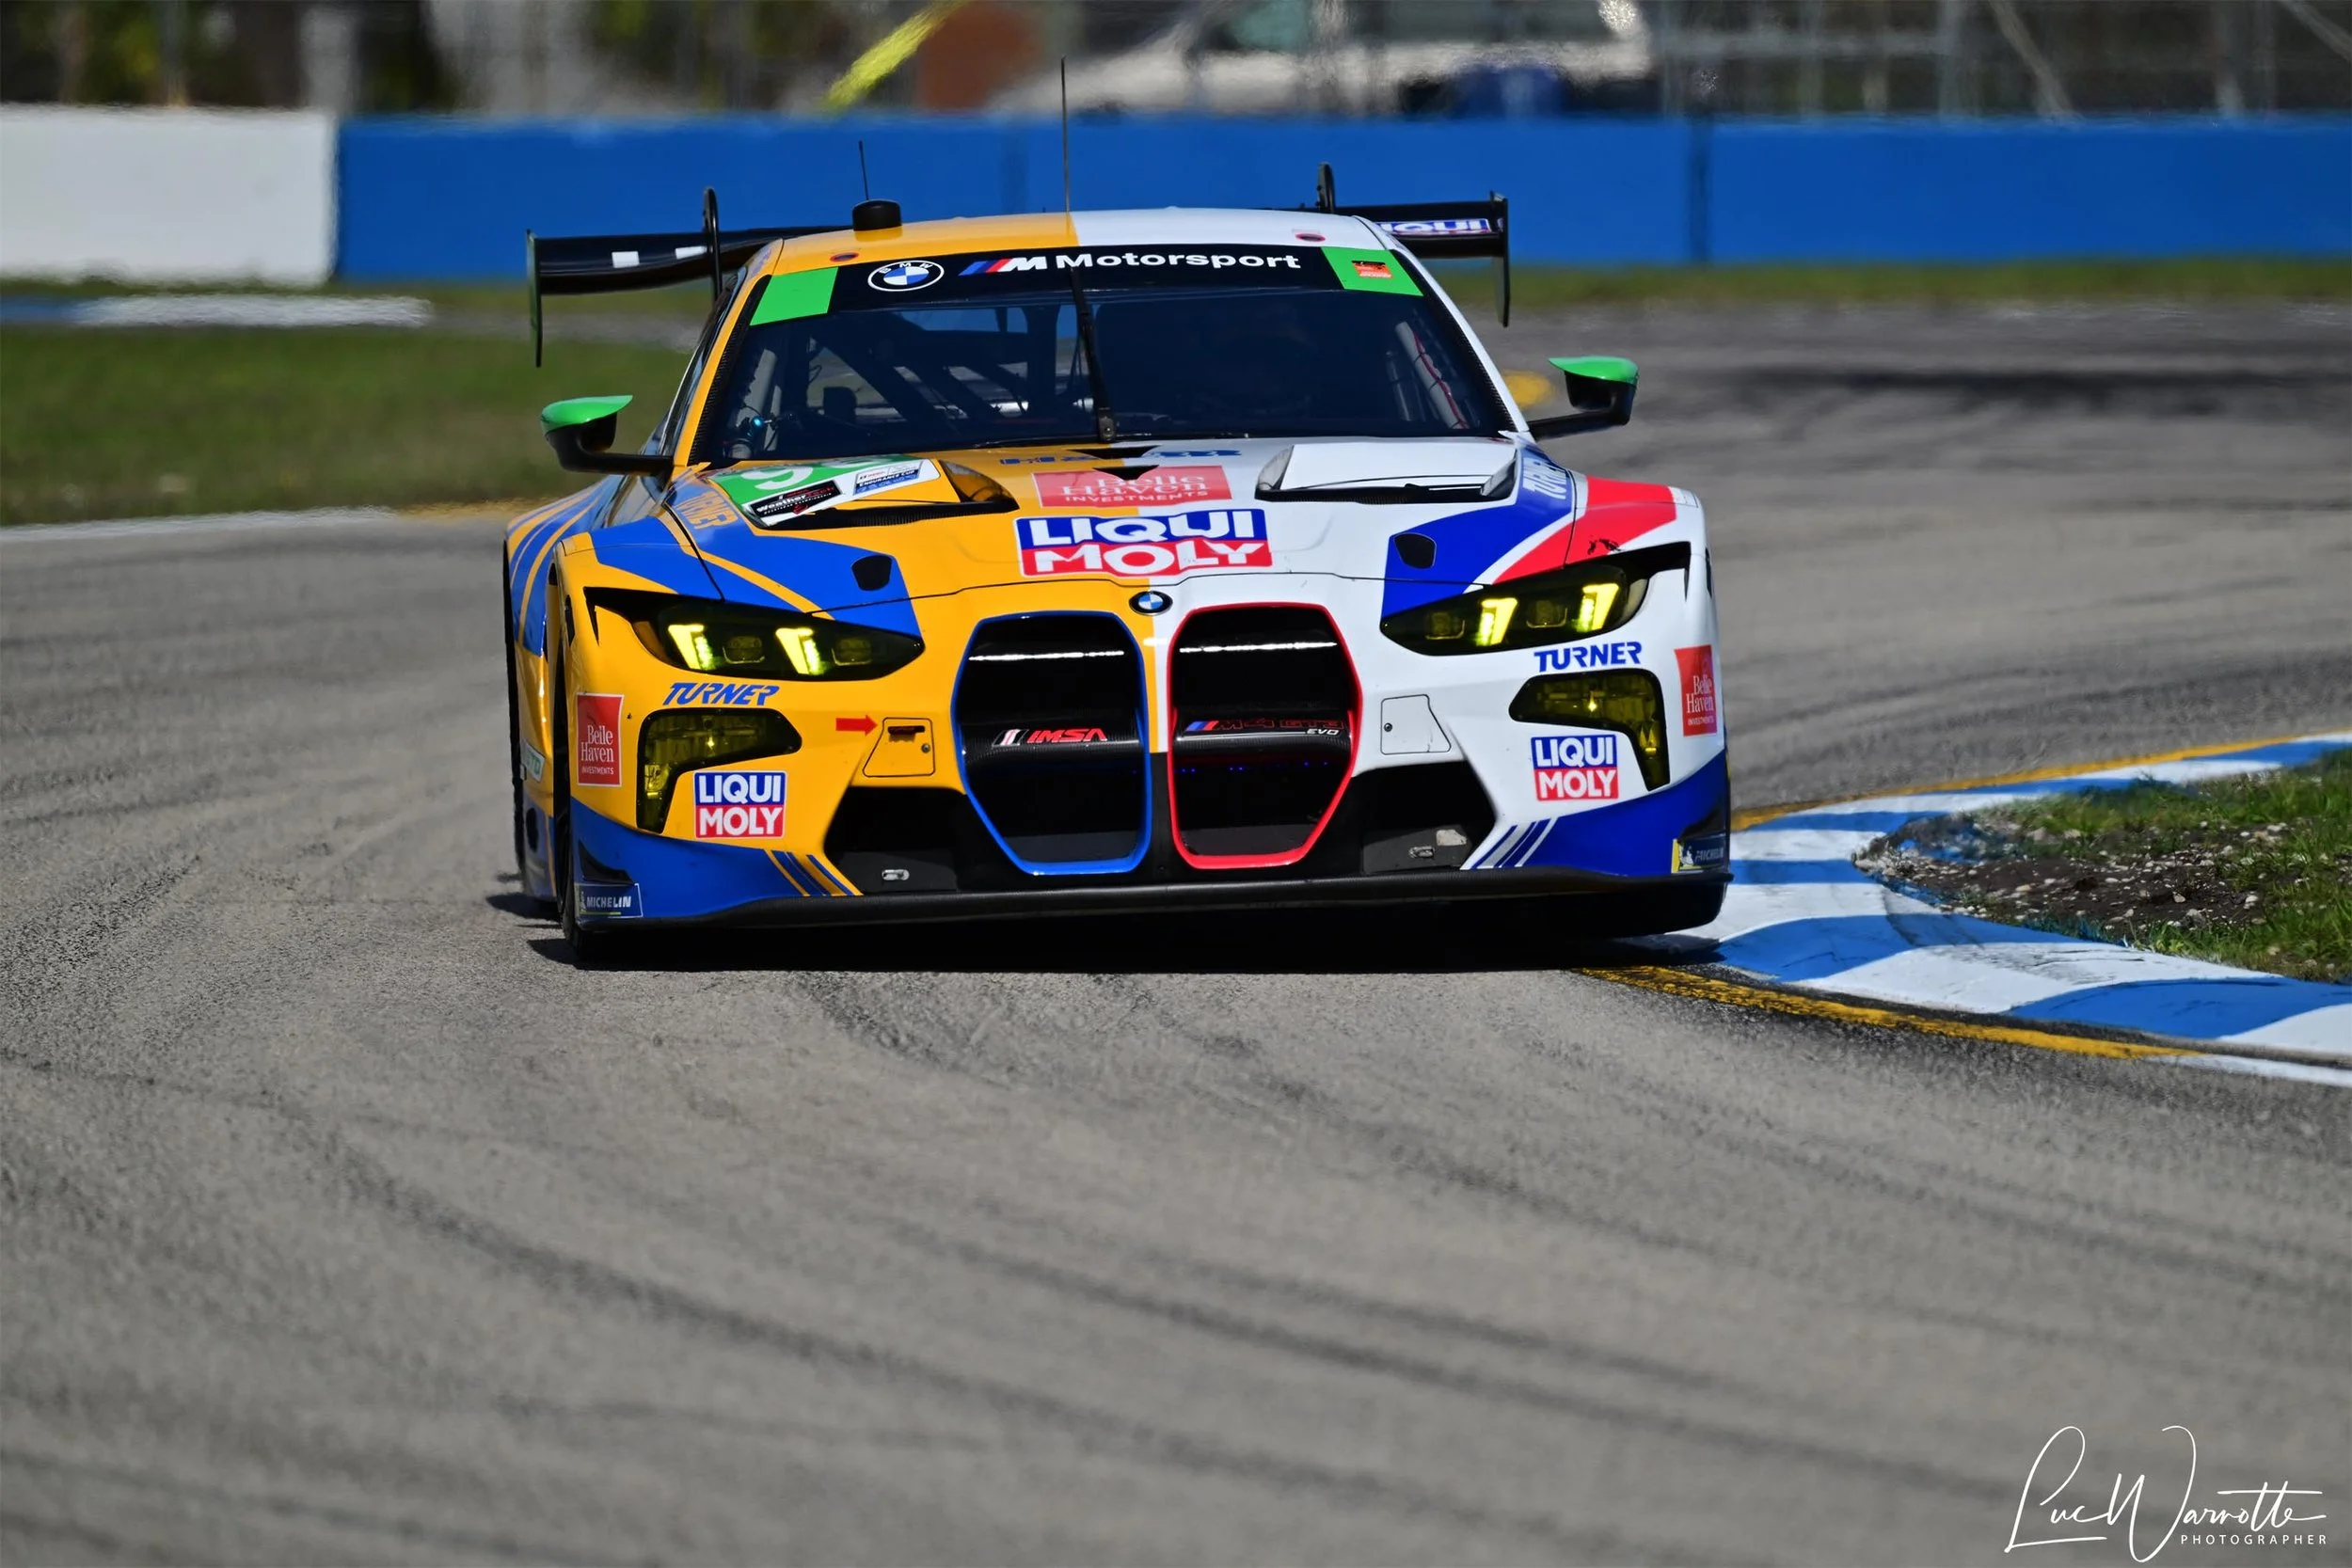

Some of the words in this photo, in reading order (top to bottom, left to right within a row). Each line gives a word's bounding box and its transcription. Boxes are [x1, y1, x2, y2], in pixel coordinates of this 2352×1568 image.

[1379, 219, 1483, 232] IQUI
[879, 262, 933, 274] BMW
[1056, 253, 1301, 269] Motorsport
[1061, 483, 1209, 496] Haven
[1065, 491, 1208, 501] INVESTMENTS
[1028, 511, 1255, 546] LIQUI
[1036, 540, 1265, 574] MOLY
[1534, 641, 1643, 673] TURNER
[662, 682, 780, 705] TURNER
[1686, 693, 1714, 714] Haven
[587, 725, 613, 746] Belle
[1026, 728, 1108, 744] IMSA
[1306, 728, 1340, 736] EVO
[580, 742, 614, 763] Haven
[1534, 736, 1614, 768] LIQUI
[698, 773, 782, 804] LIQUI
[1537, 768, 1617, 799] MOLY
[699, 806, 783, 836] MOLY
[586, 895, 632, 909] MICHELIN
